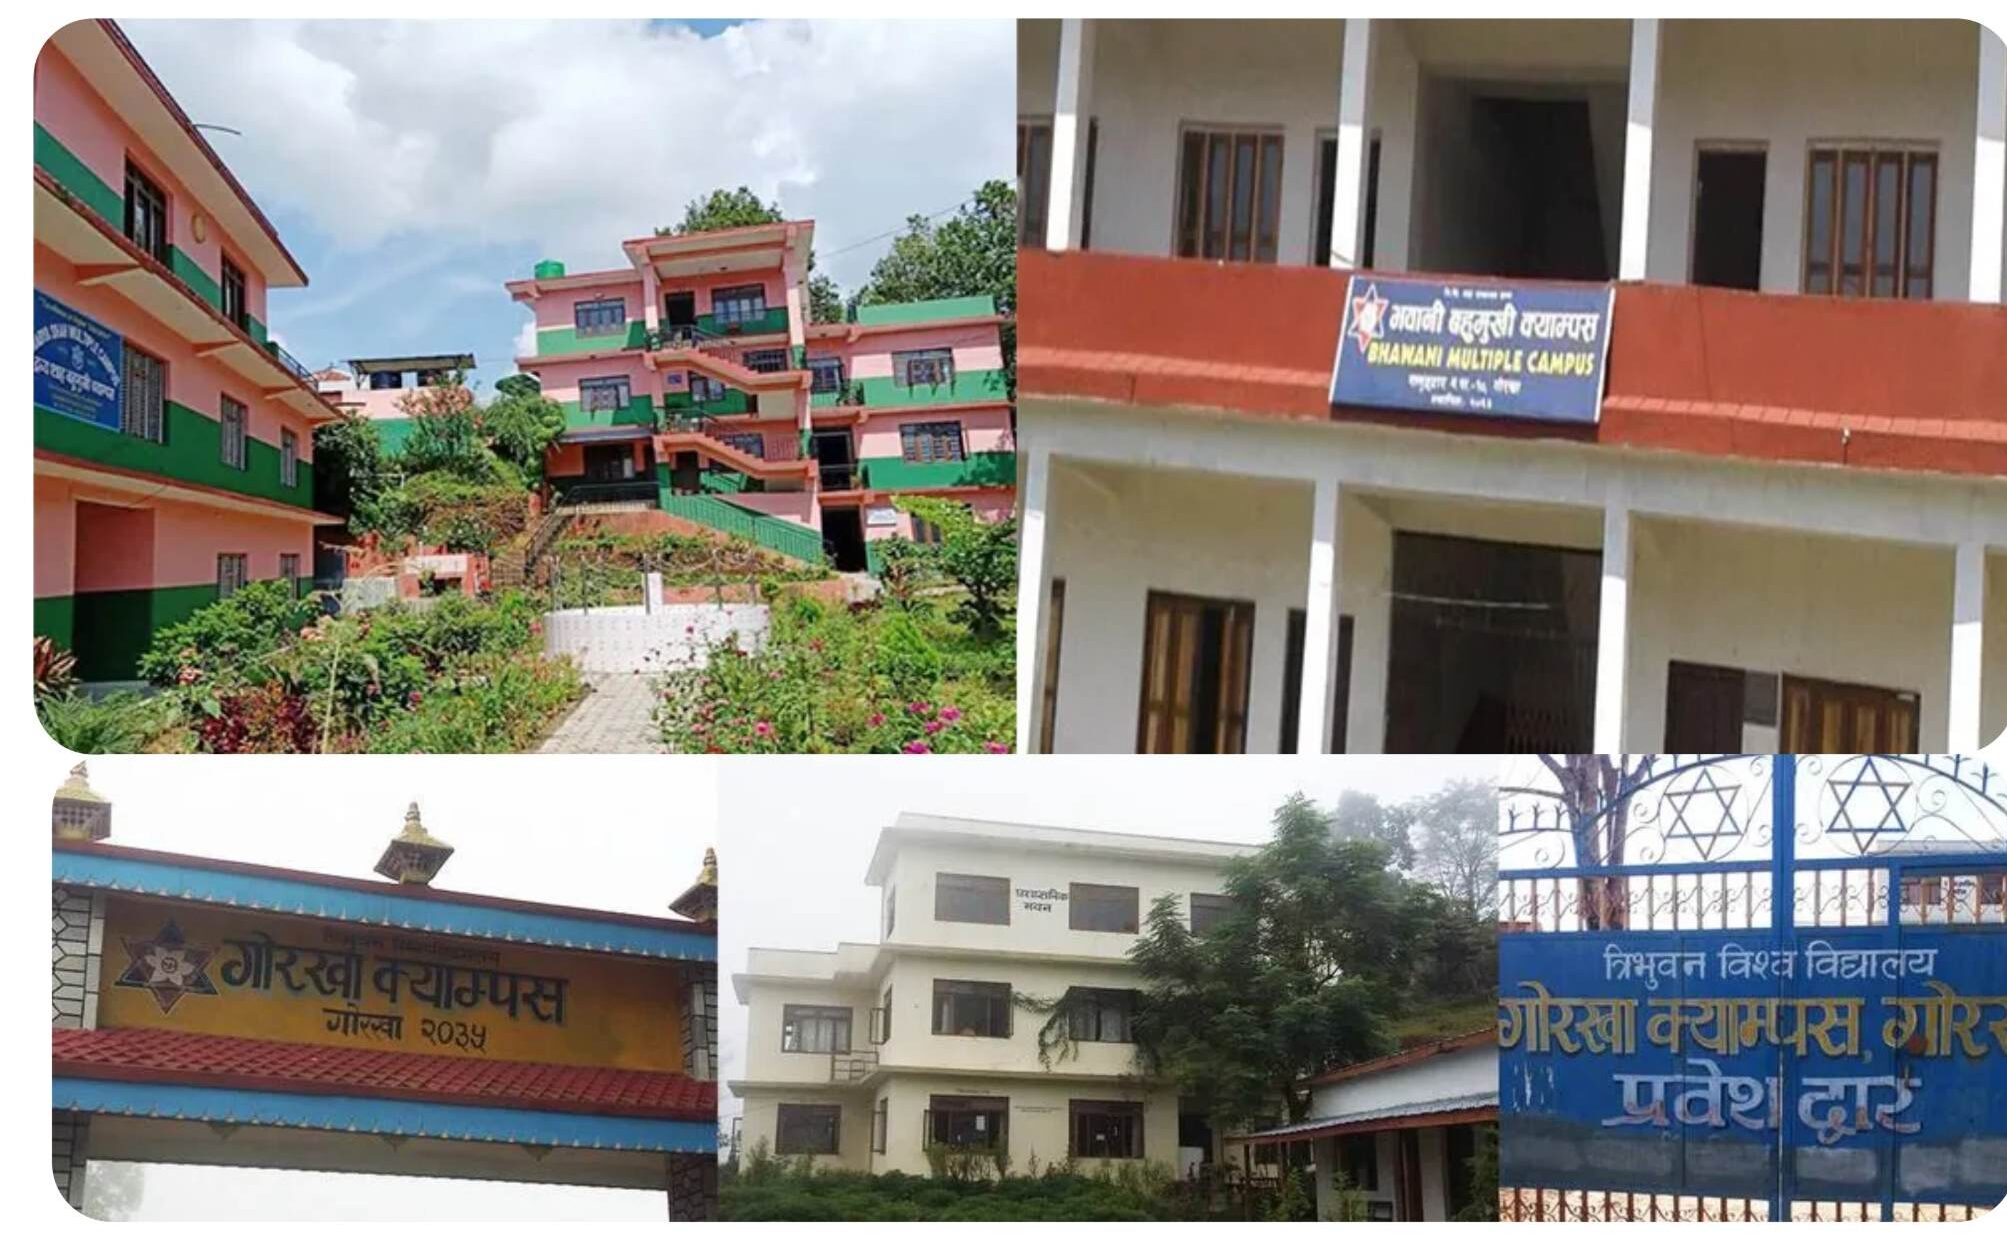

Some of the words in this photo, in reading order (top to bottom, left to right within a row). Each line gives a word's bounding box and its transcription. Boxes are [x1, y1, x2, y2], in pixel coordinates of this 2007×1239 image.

[1519, 311, 1600, 343] क्याम्पस
[1367, 341, 1442, 369] BHAWANI
[1446, 347, 1523, 373] MULTIPLE
[1526, 351, 1595, 376] CAMPUS
[220, 931, 362, 1001] गोरखा
[372, 955, 569, 1025] क्याम्पस
[1603, 943, 1706, 991] त्रिभुवन
[1717, 943, 1798, 980] विश्व
[1805, 940, 1938, 980] विद्यालय
[322, 1002, 404, 1041] गोरखा
[421, 1018, 487, 1054] २०३५
[1498, 980, 1638, 1054] गोरखा
[1601, 1057, 1781, 1130] प्रवेश
[1798, 1074, 1922, 1144] द्वार
